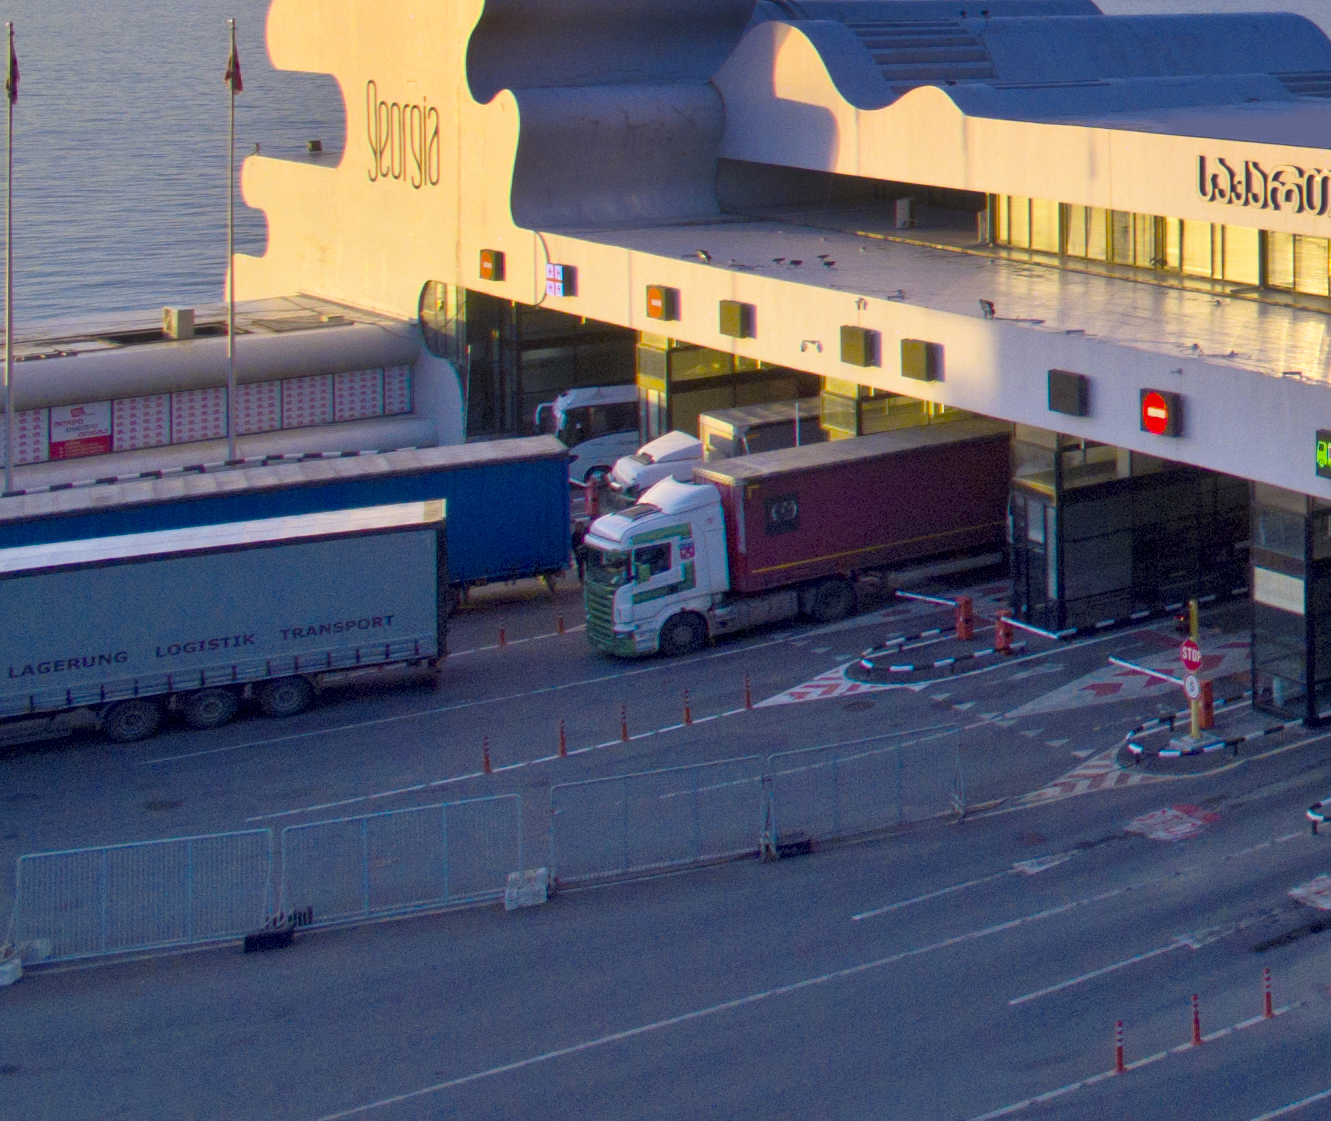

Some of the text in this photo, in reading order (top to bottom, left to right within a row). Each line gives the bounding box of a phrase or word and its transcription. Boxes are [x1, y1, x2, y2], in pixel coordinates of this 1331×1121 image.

[8, 615, 395, 679] LAGERUNG LOGISTIK TRANSPORT
[1182, 645, 1202, 663] STOP
